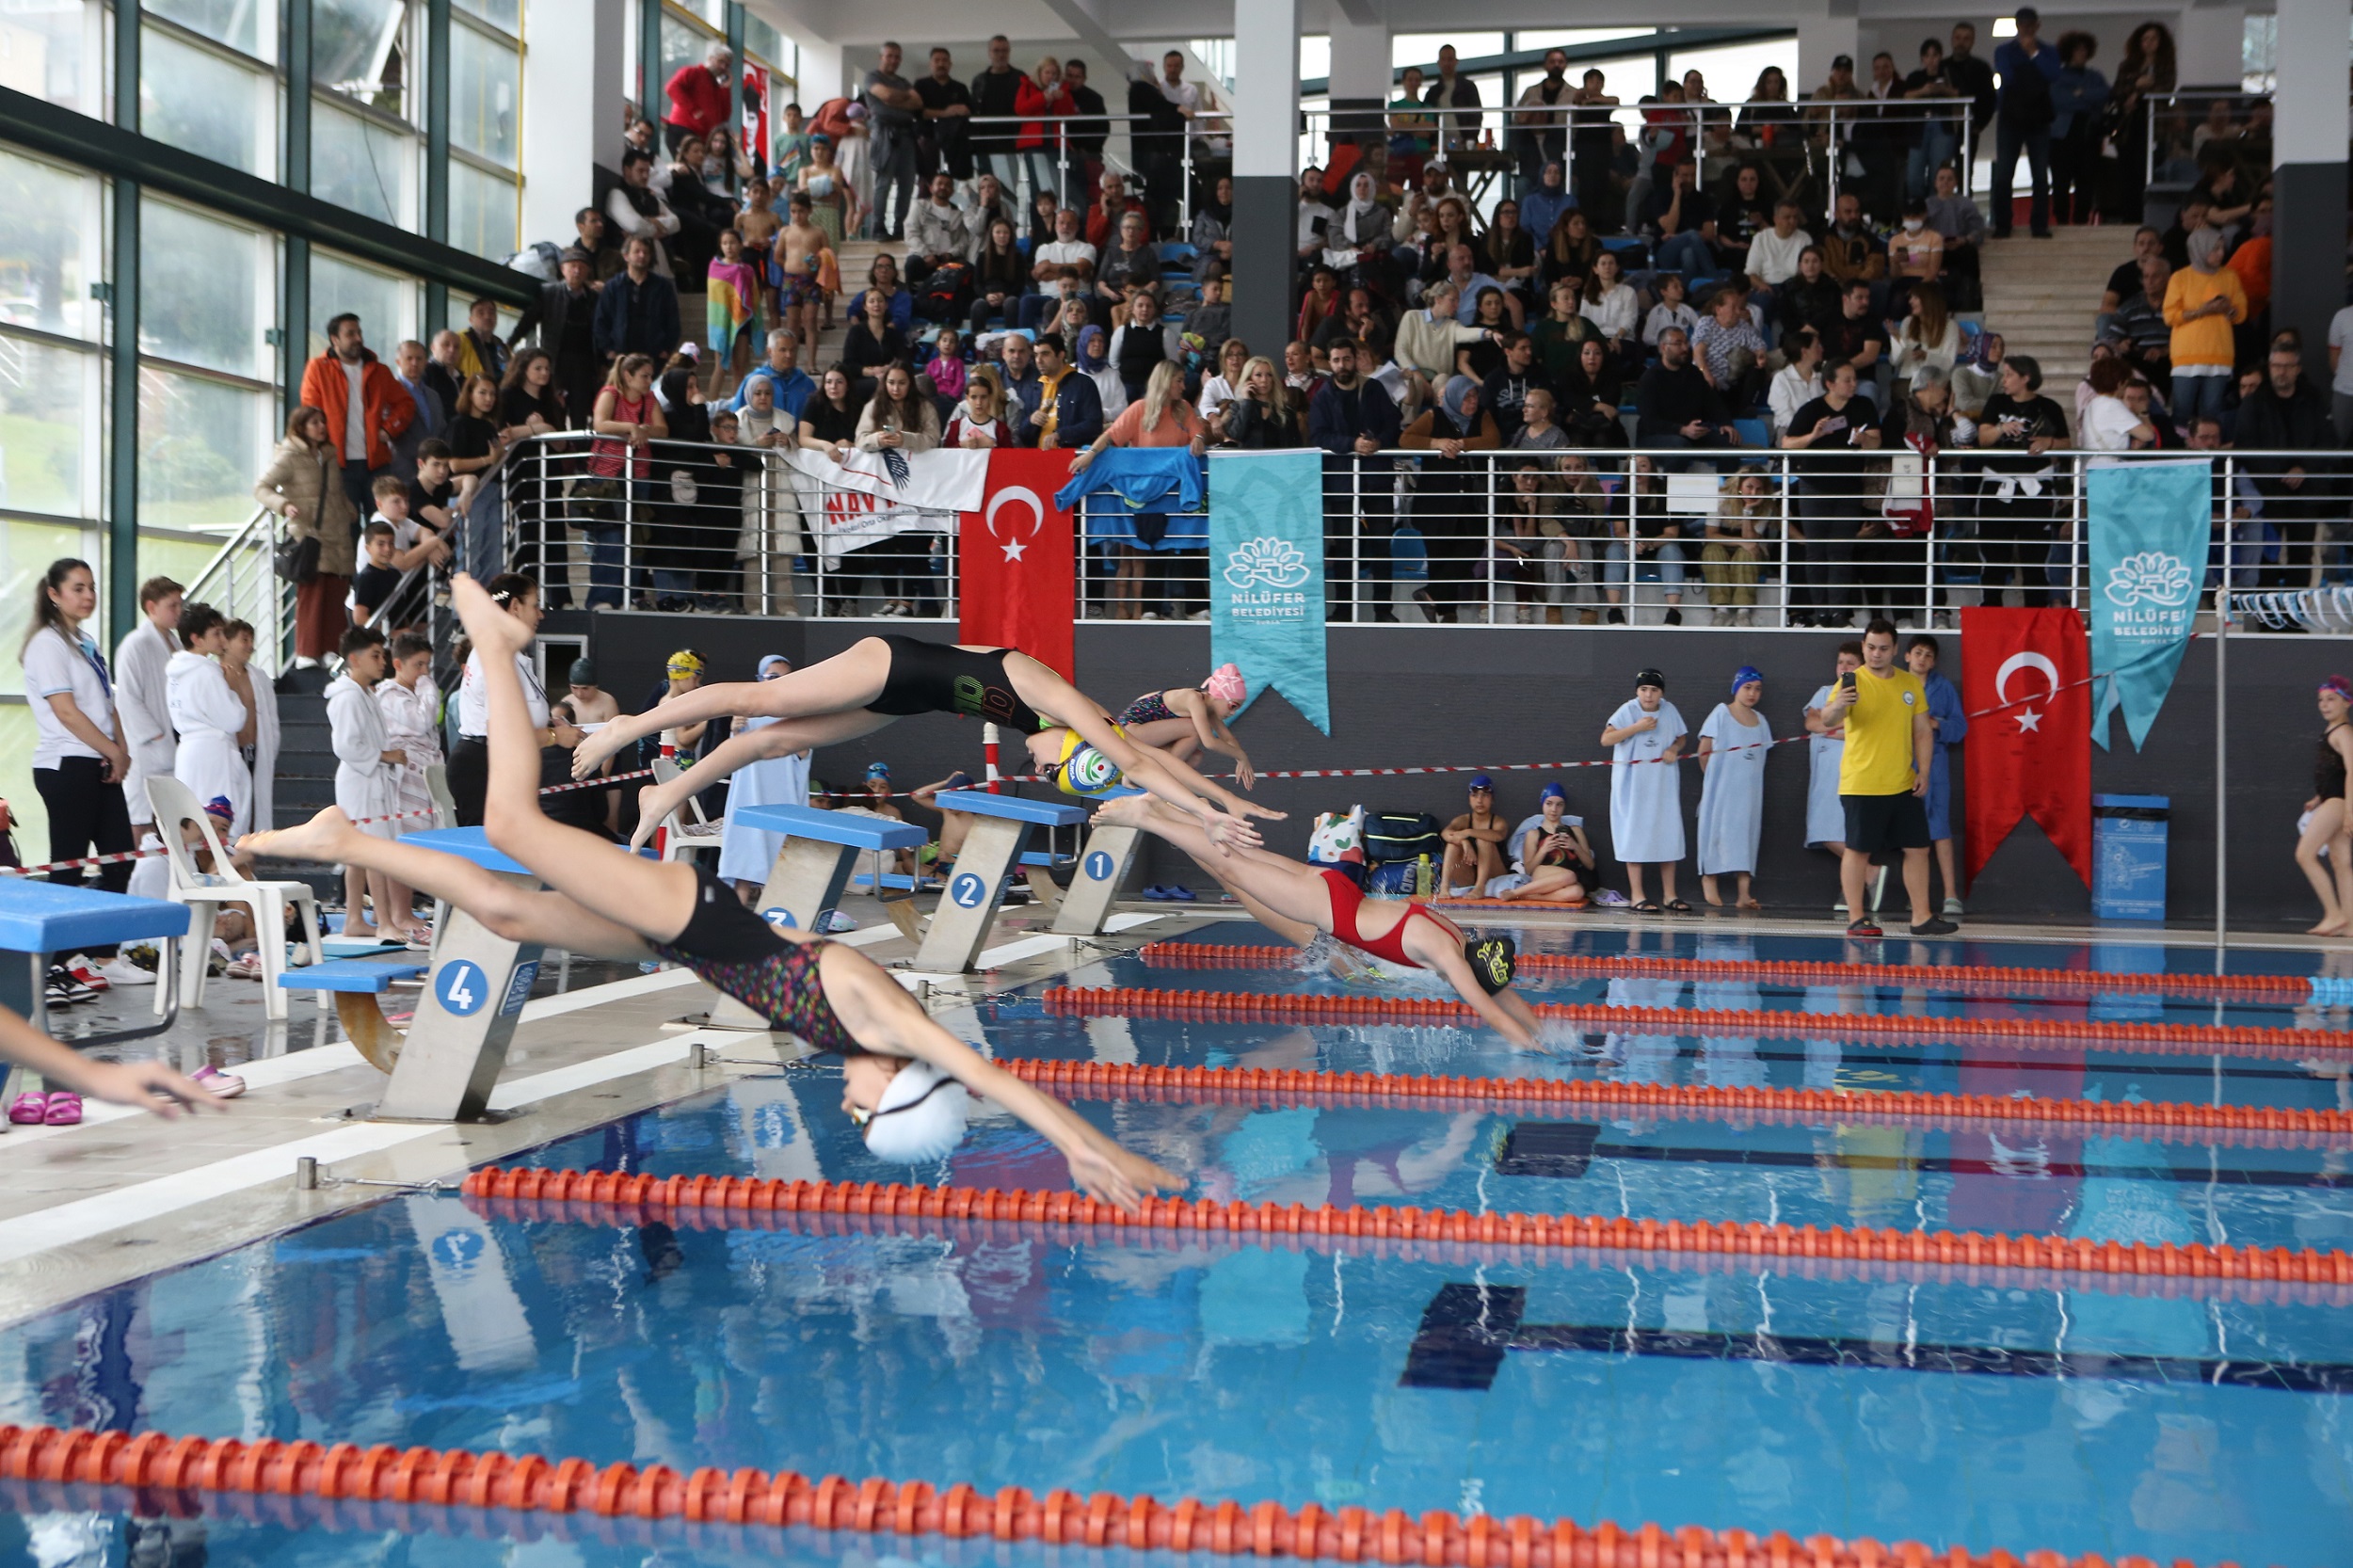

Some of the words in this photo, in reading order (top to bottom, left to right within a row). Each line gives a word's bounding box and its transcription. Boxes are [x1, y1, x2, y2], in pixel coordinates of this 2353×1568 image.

[1231, 590, 1306, 603] NİLÜFER
[1231, 605, 1305, 617] BELEDİYESİ
[1068, 758, 1077, 781] BURSA
[1095, 855, 1104, 878] 1
[959, 877, 978, 905] 2
[447, 966, 473, 1010] 4
